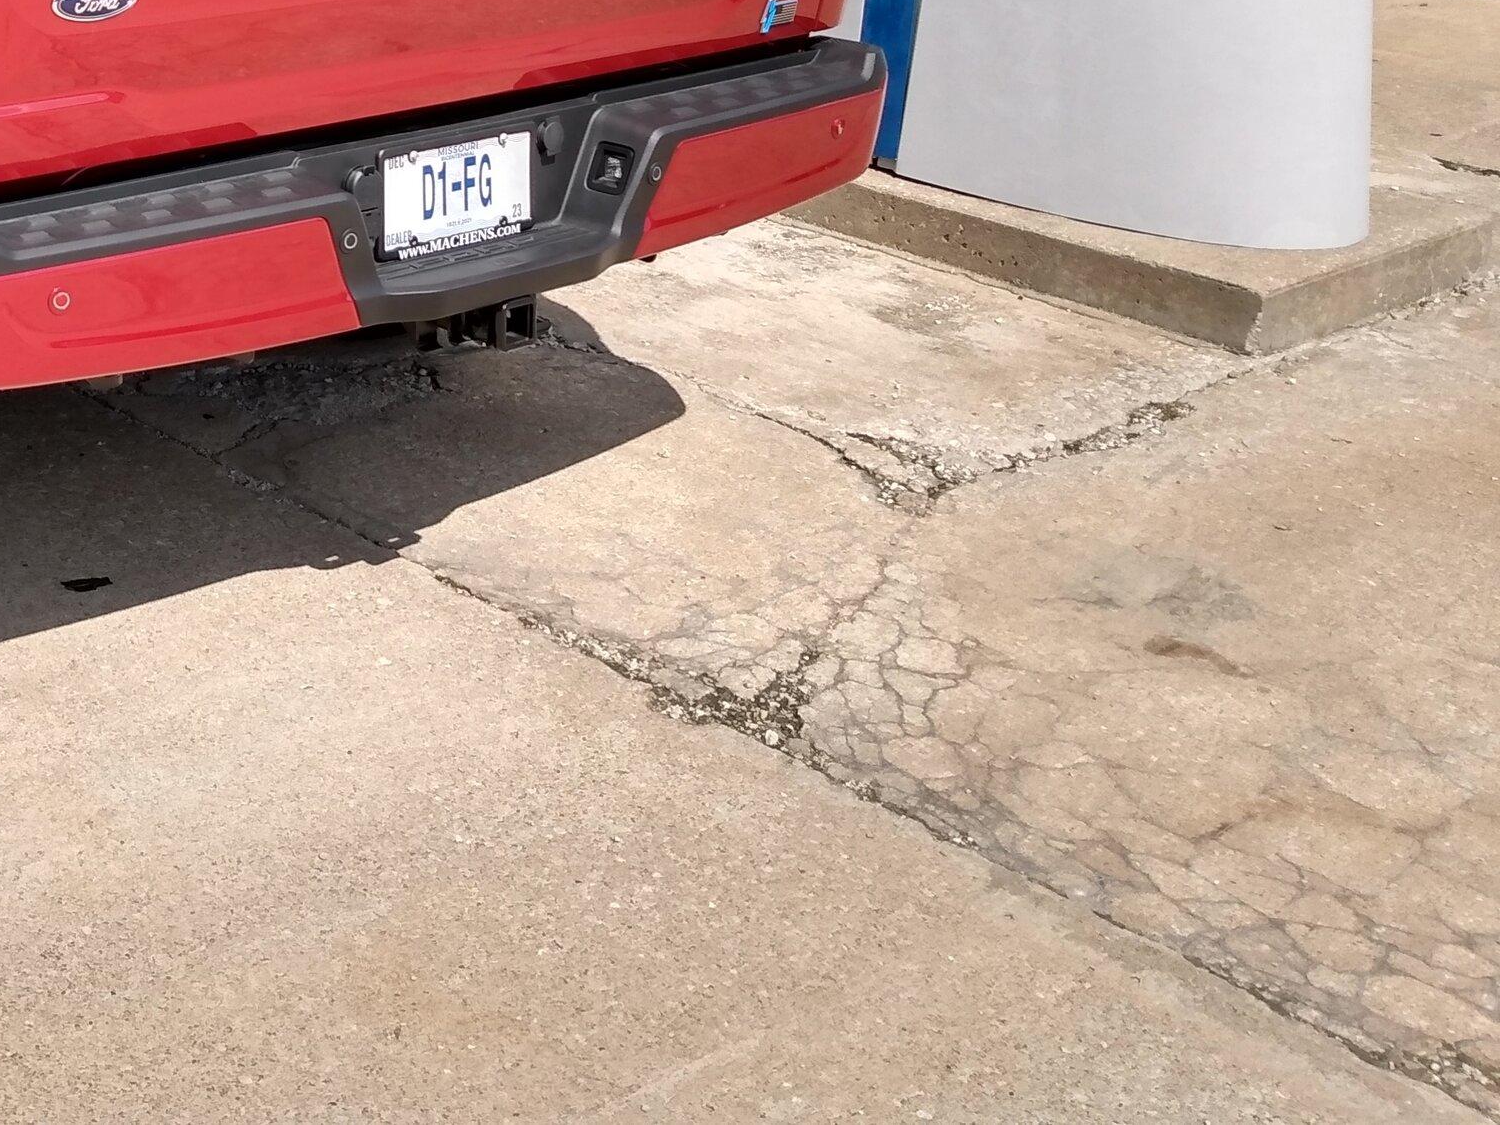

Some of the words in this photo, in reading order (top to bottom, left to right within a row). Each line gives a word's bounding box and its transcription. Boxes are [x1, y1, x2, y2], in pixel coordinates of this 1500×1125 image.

[437, 141, 479, 157] MISSOURI
[388, 156, 405, 170] DEC
[422, 153, 492, 221] D1-FG
[512, 202, 523, 218] 23
